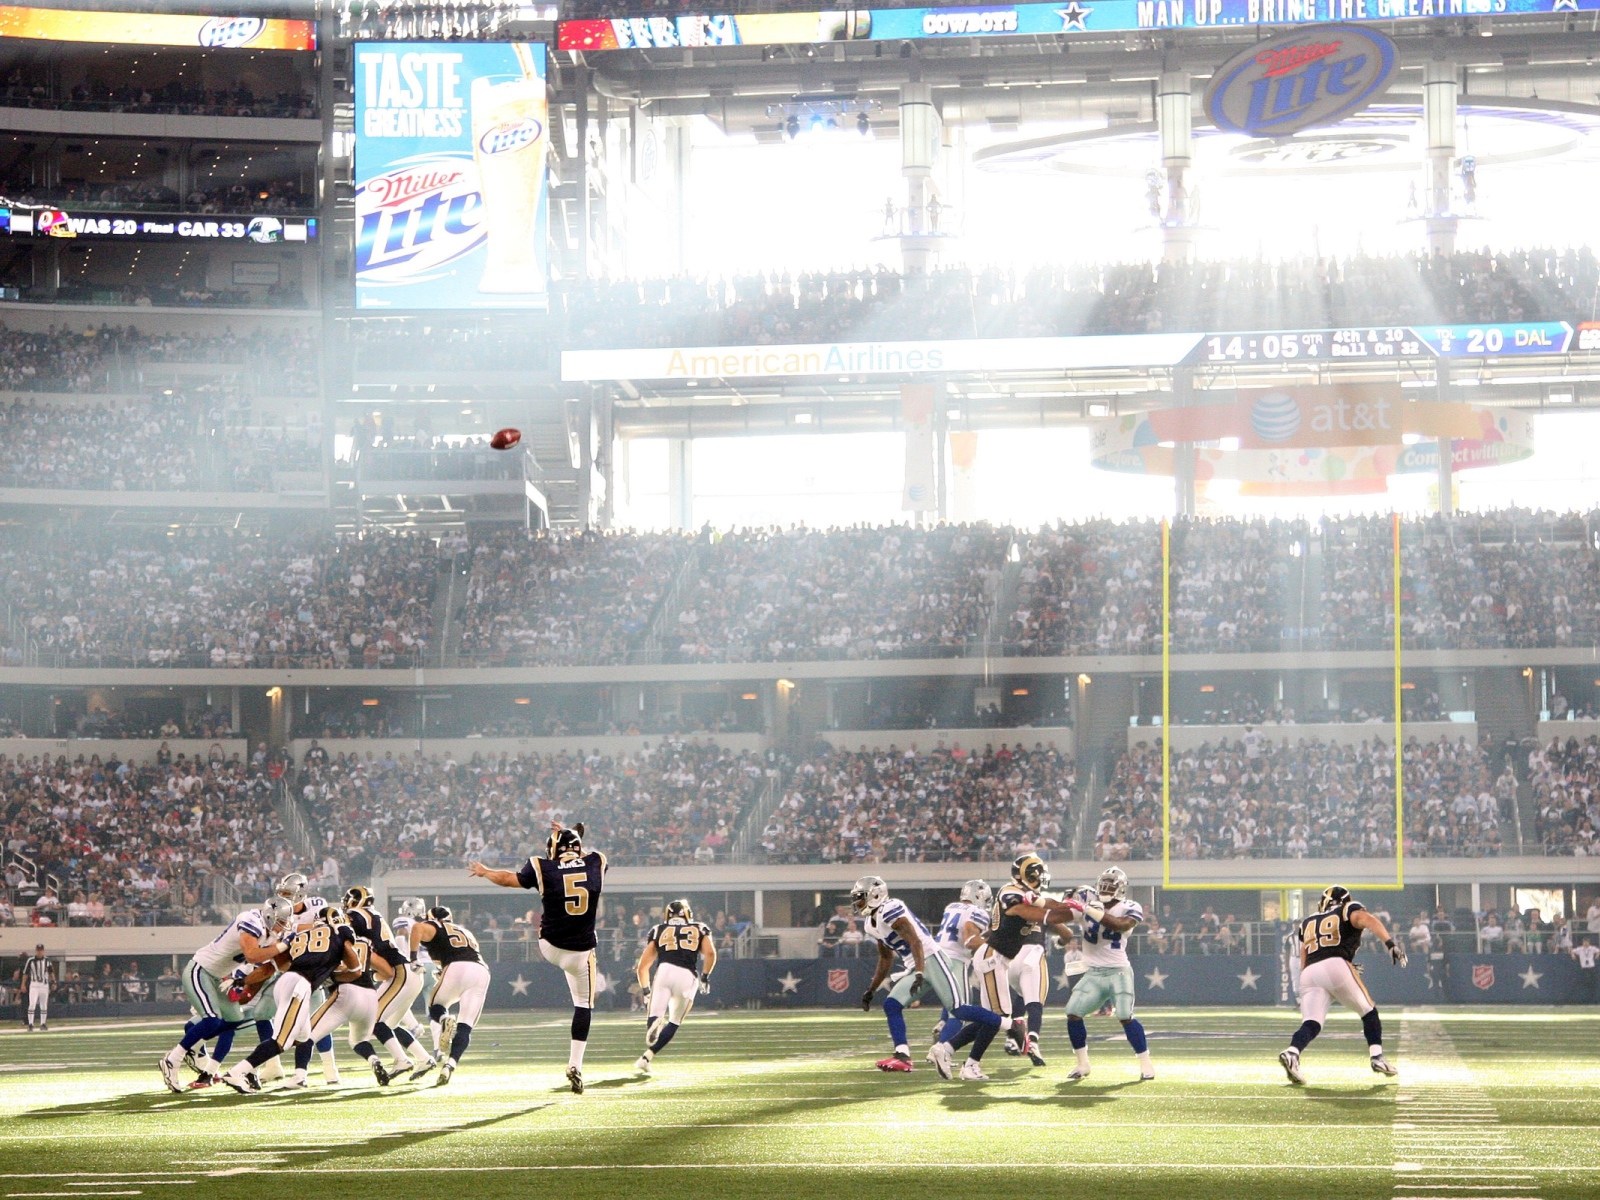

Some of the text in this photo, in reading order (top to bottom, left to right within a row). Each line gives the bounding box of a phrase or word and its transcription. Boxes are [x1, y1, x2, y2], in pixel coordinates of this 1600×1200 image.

[923, 12, 1018, 34] COWBOYS
[1137, 1, 1184, 27] MAN
[1328, 0, 1367, 19] THE
[1256, 41, 1344, 76] Miller
[359, 52, 464, 108] TASTE
[1246, 54, 1368, 131] Lite
[490, 126, 533, 154] Lite
[367, 172, 464, 207] Miller
[68, 218, 246, 238] WAS 20 Final CAR 33
[356, 191, 483, 274] Lite
[1207, 334, 1300, 361] 14:05
[1301, 333, 1324, 345] QTR
[1306, 344, 1318, 356] 4
[1331, 341, 1420, 357] Ball On 32
[1332, 330, 1361, 343] 4th
[1385, 329, 1404, 342] 10
[1441, 339, 1451, 352] 2
[1466, 328, 1553, 353] 20 DAL
[1310, 398, 1392, 433] at&t
[562, 872, 589, 916] 5
[658, 925, 700, 951] 43
[935, 912, 962, 943] 24
[1083, 913, 1122, 950] 34
[1303, 914, 1341, 955] 49
[290, 925, 332, 960] 88
